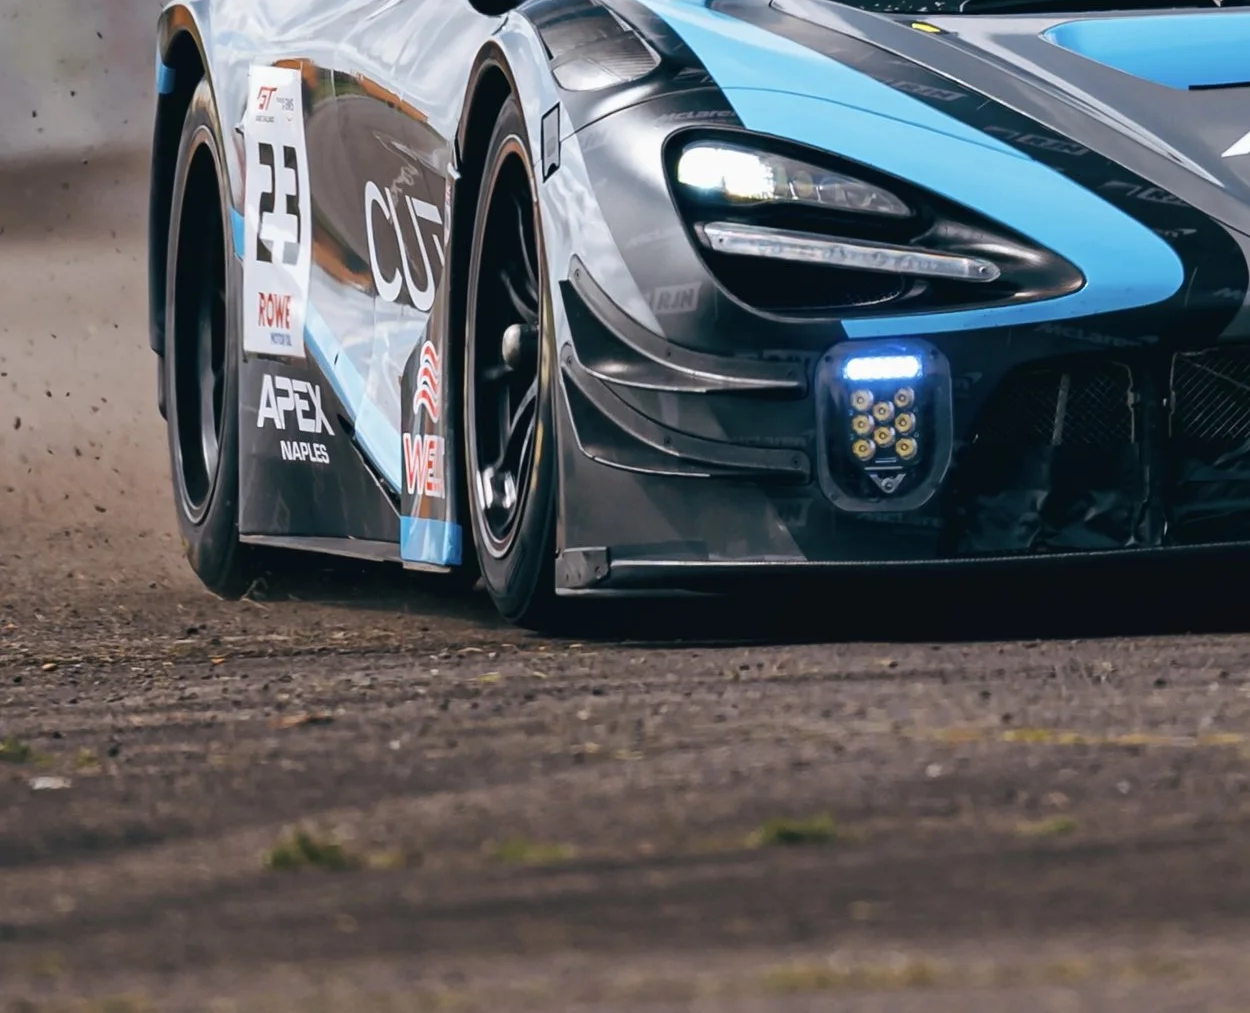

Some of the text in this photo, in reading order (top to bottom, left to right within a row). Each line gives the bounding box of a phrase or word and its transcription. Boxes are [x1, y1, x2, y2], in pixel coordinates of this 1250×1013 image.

[256, 142, 301, 265] 23
[258, 292, 292, 330] ROWE
[256, 374, 335, 436] APEX
[280, 440, 330, 464] NAPLES
